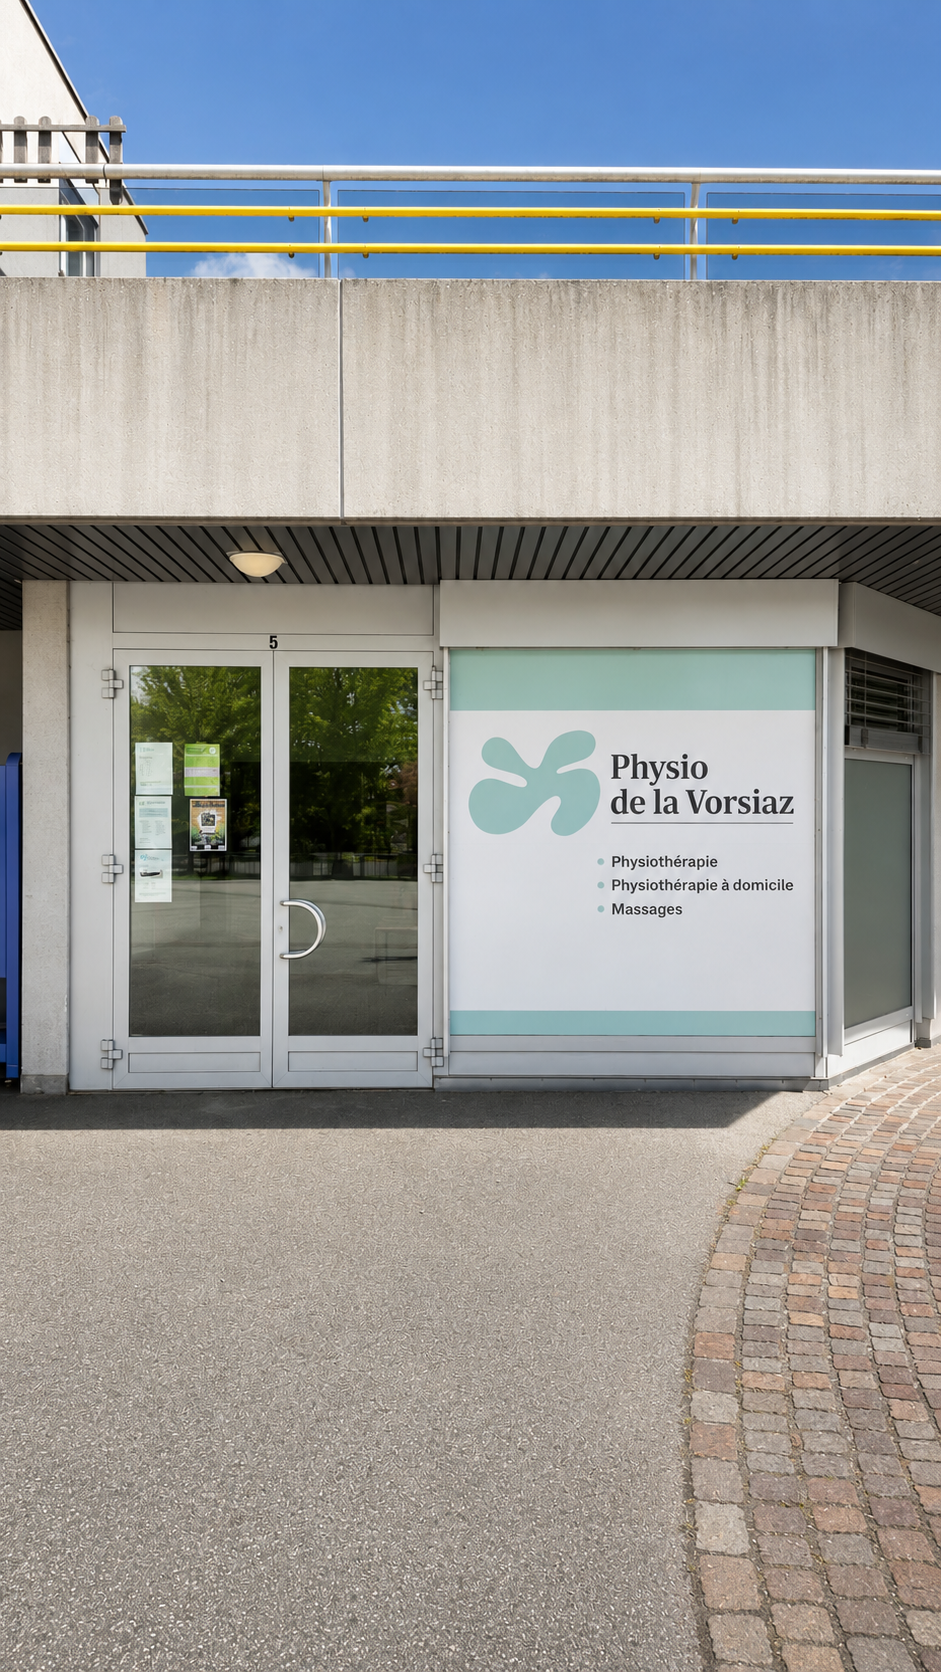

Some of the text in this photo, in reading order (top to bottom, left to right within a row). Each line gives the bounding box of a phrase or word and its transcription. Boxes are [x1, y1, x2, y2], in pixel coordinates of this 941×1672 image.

[269, 635, 278, 649] 5
[611, 753, 708, 786] Physio
[611, 788, 794, 814] de la Vorsiaz
[612, 855, 717, 870] Physiothérapie
[612, 879, 793, 894] Physiothérapie à domicile
[612, 903, 682, 918] Massages
